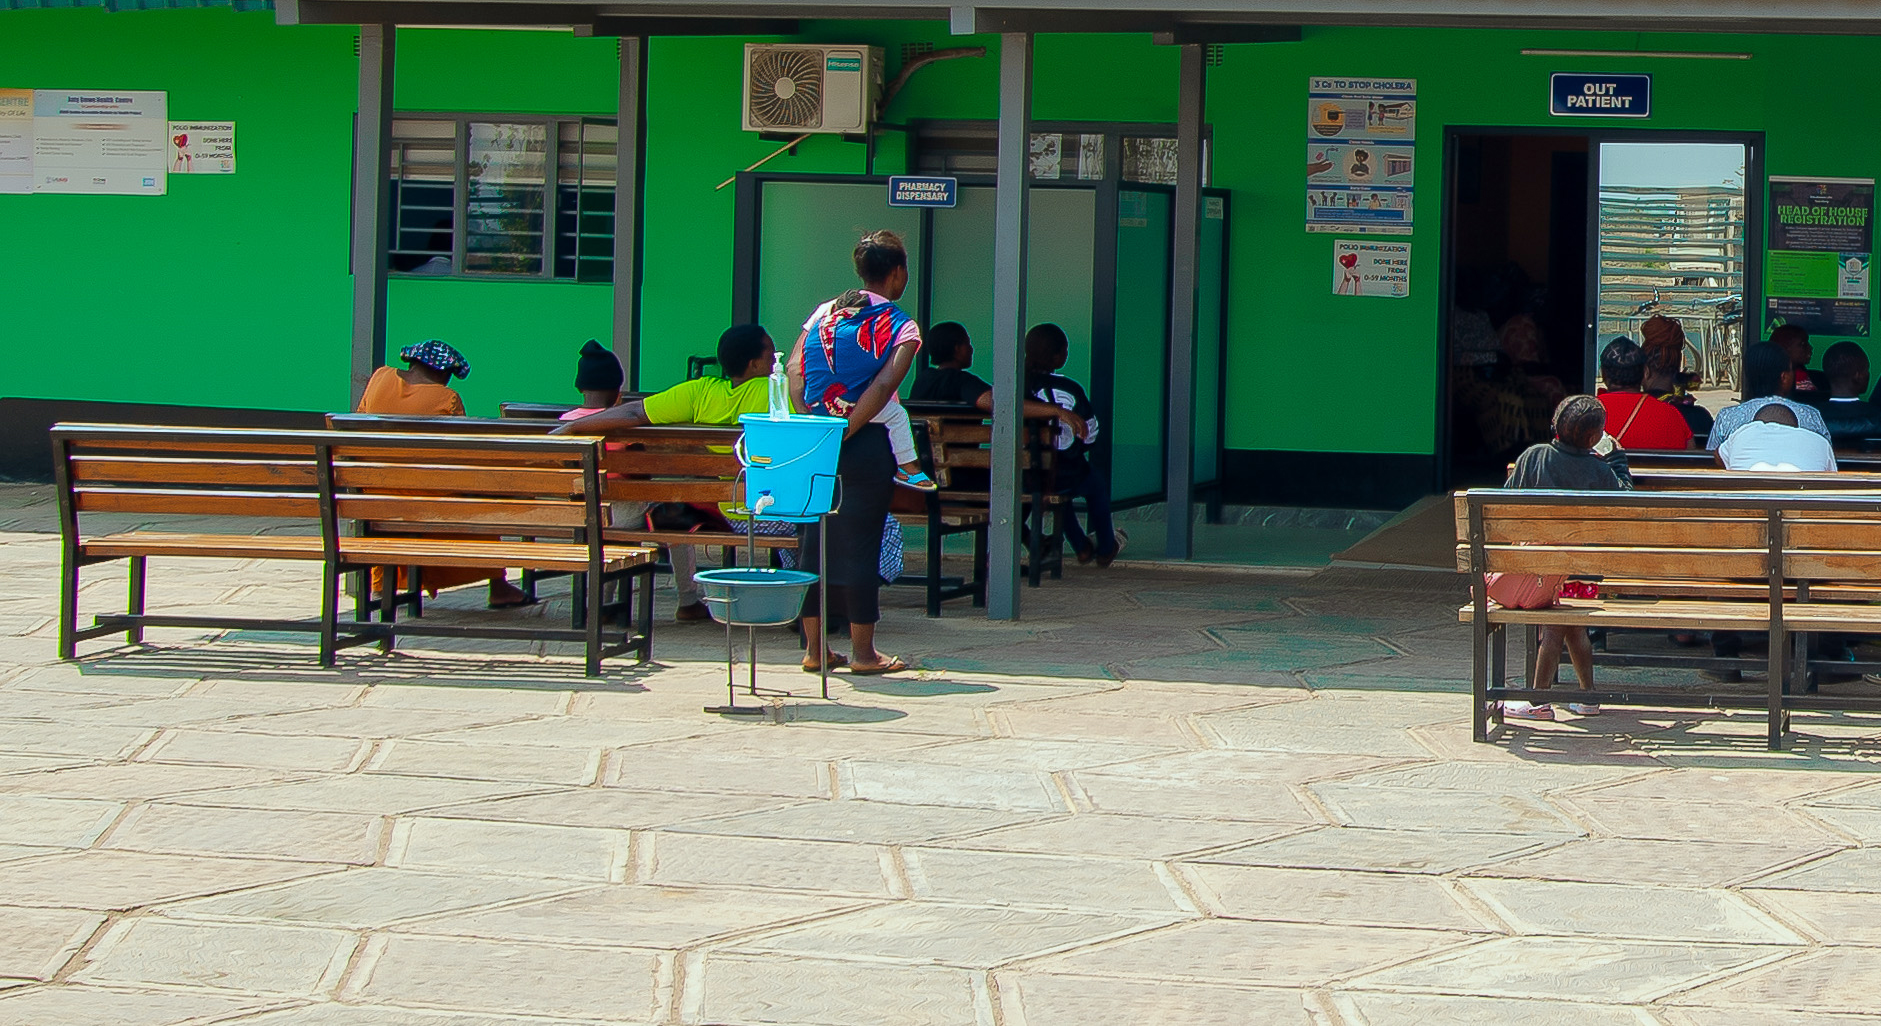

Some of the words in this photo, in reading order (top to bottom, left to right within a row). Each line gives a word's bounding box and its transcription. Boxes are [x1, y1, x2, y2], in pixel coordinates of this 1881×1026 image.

[1314, 80, 1320, 88] 3
[1333, 81, 1346, 89] TO
[1348, 81, 1371, 89] STOP
[1372, 81, 1412, 90] CHOLERA
[1583, 83, 1617, 95] OUT
[1567, 95, 1633, 108] PATIENT
[898, 182, 946, 191] PHARMACY
[896, 191, 949, 201] DISPENSARY
[1777, 205, 1809, 215] HEAD
[1811, 206, 1828, 215] OF
[1828, 207, 1868, 217] HOUSE
[1780, 214, 1865, 226] REGISTRATION
